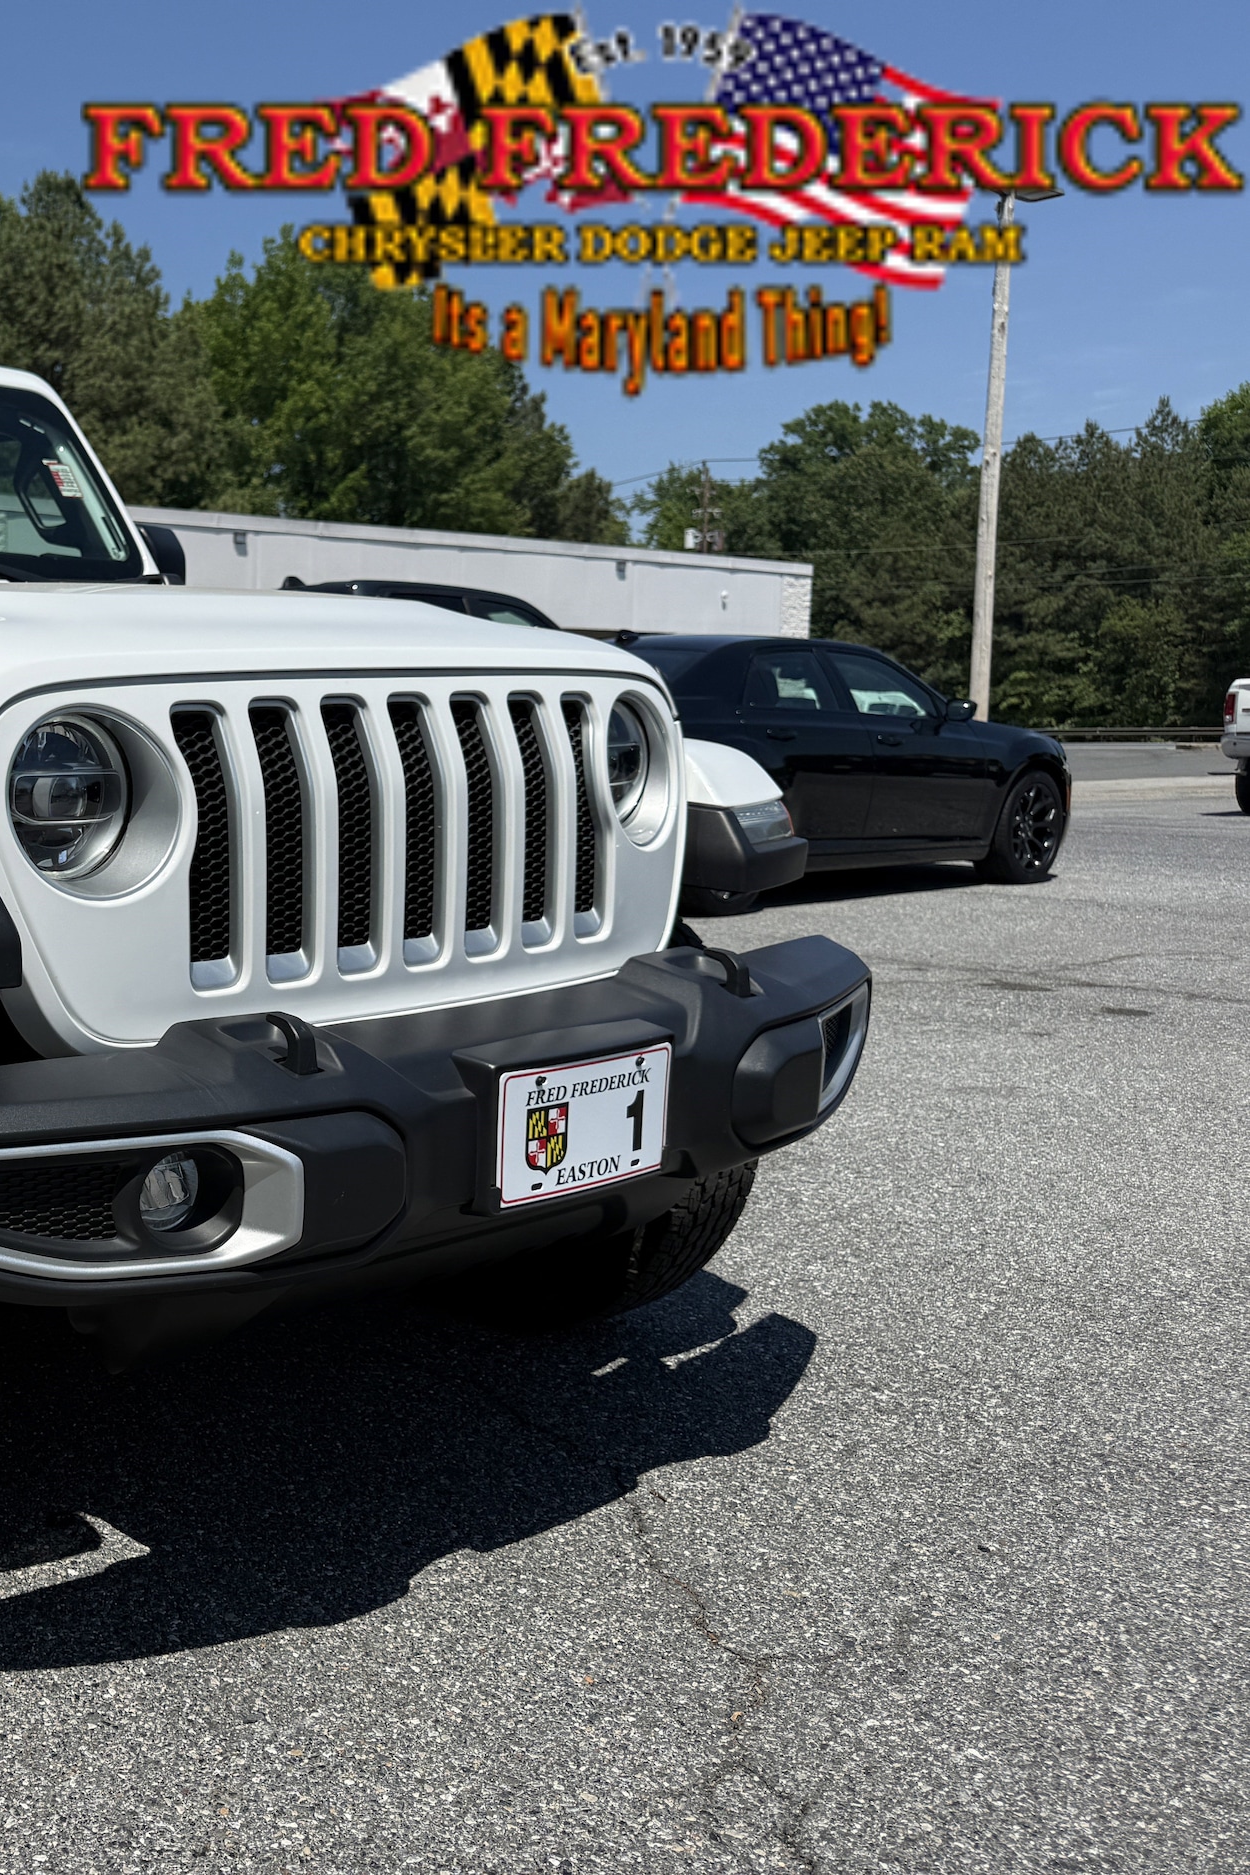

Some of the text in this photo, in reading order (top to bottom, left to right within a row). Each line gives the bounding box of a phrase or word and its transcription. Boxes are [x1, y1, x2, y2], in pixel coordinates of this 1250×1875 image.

[525, 1067, 652, 1107] FRED FREDERICK
[626, 1089, 645, 1152] 1
[555, 1155, 621, 1187] EASTON
